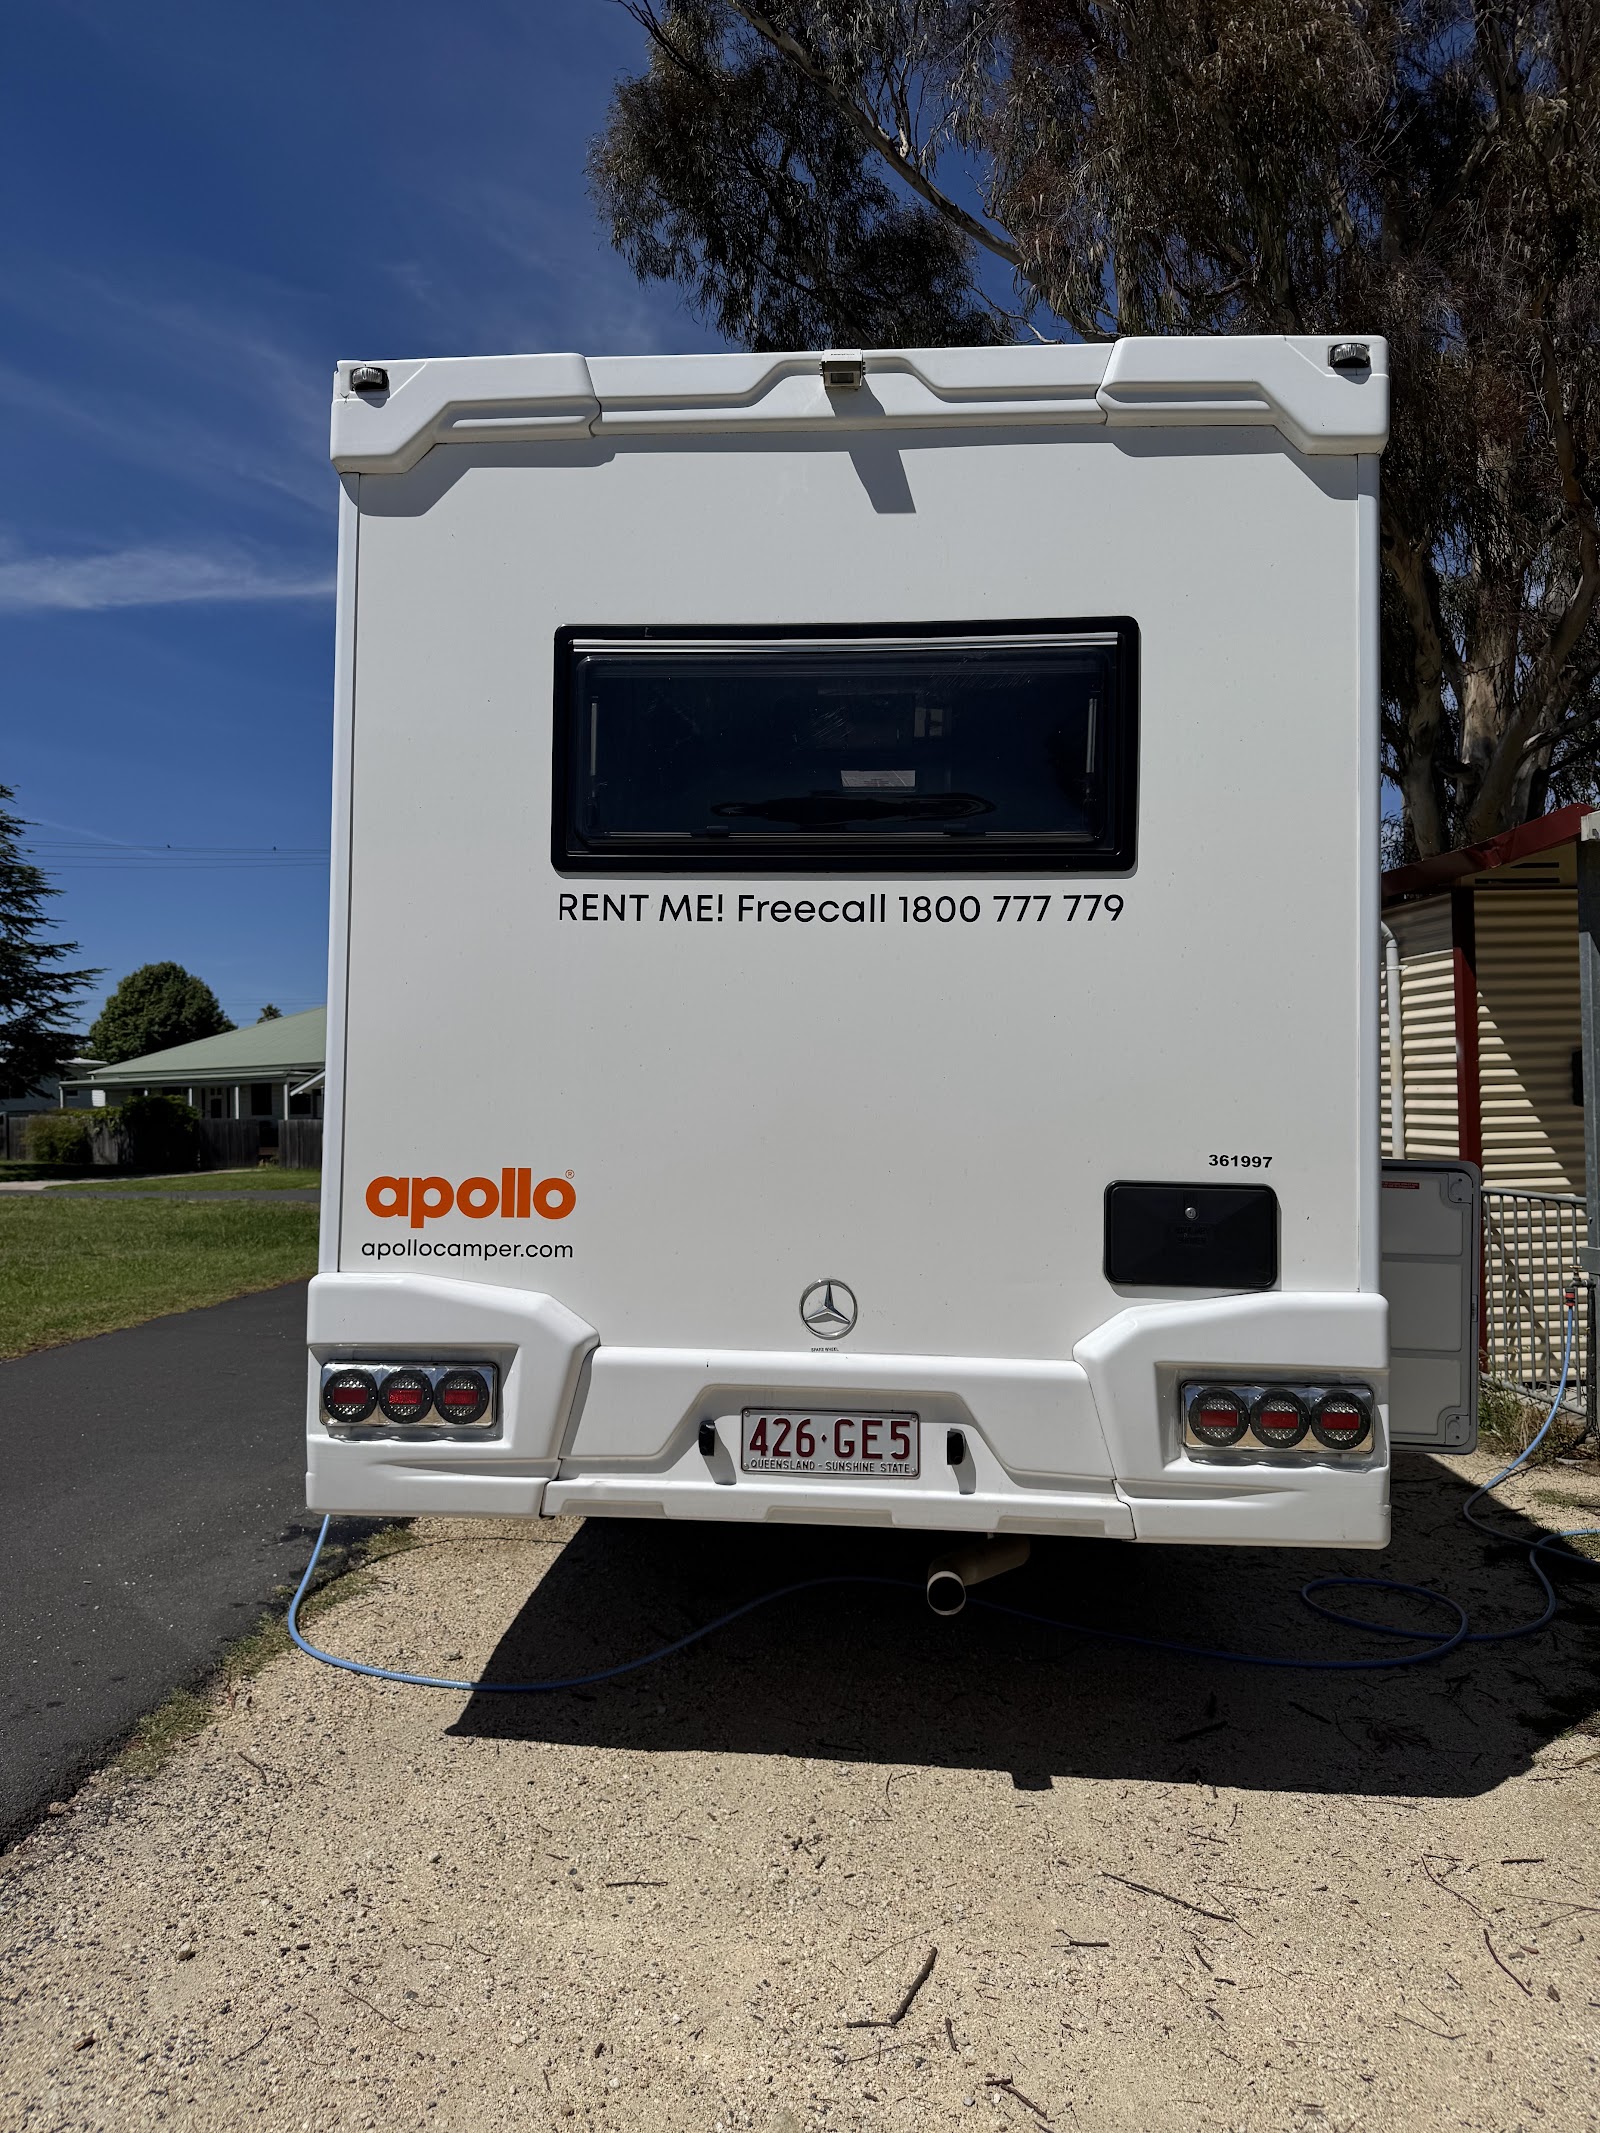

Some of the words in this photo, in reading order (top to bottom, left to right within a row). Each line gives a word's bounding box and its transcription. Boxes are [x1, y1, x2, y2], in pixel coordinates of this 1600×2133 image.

[559, 893, 649, 922] RENT
[658, 893, 723, 922] ME!
[738, 893, 886, 923] Freecall
[898, 895, 981, 923] 1800
[992, 895, 1051, 923] 777
[1063, 894, 1124, 922] 779
[1208, 1154, 1273, 1169] 361997
[361, 1238, 573, 1261] apollocamper.com
[750, 1458, 815, 1471] QUEENSLAND
[825, 1461, 875, 1473] SUNSHINE
[880, 1462, 910, 1474] STATE
